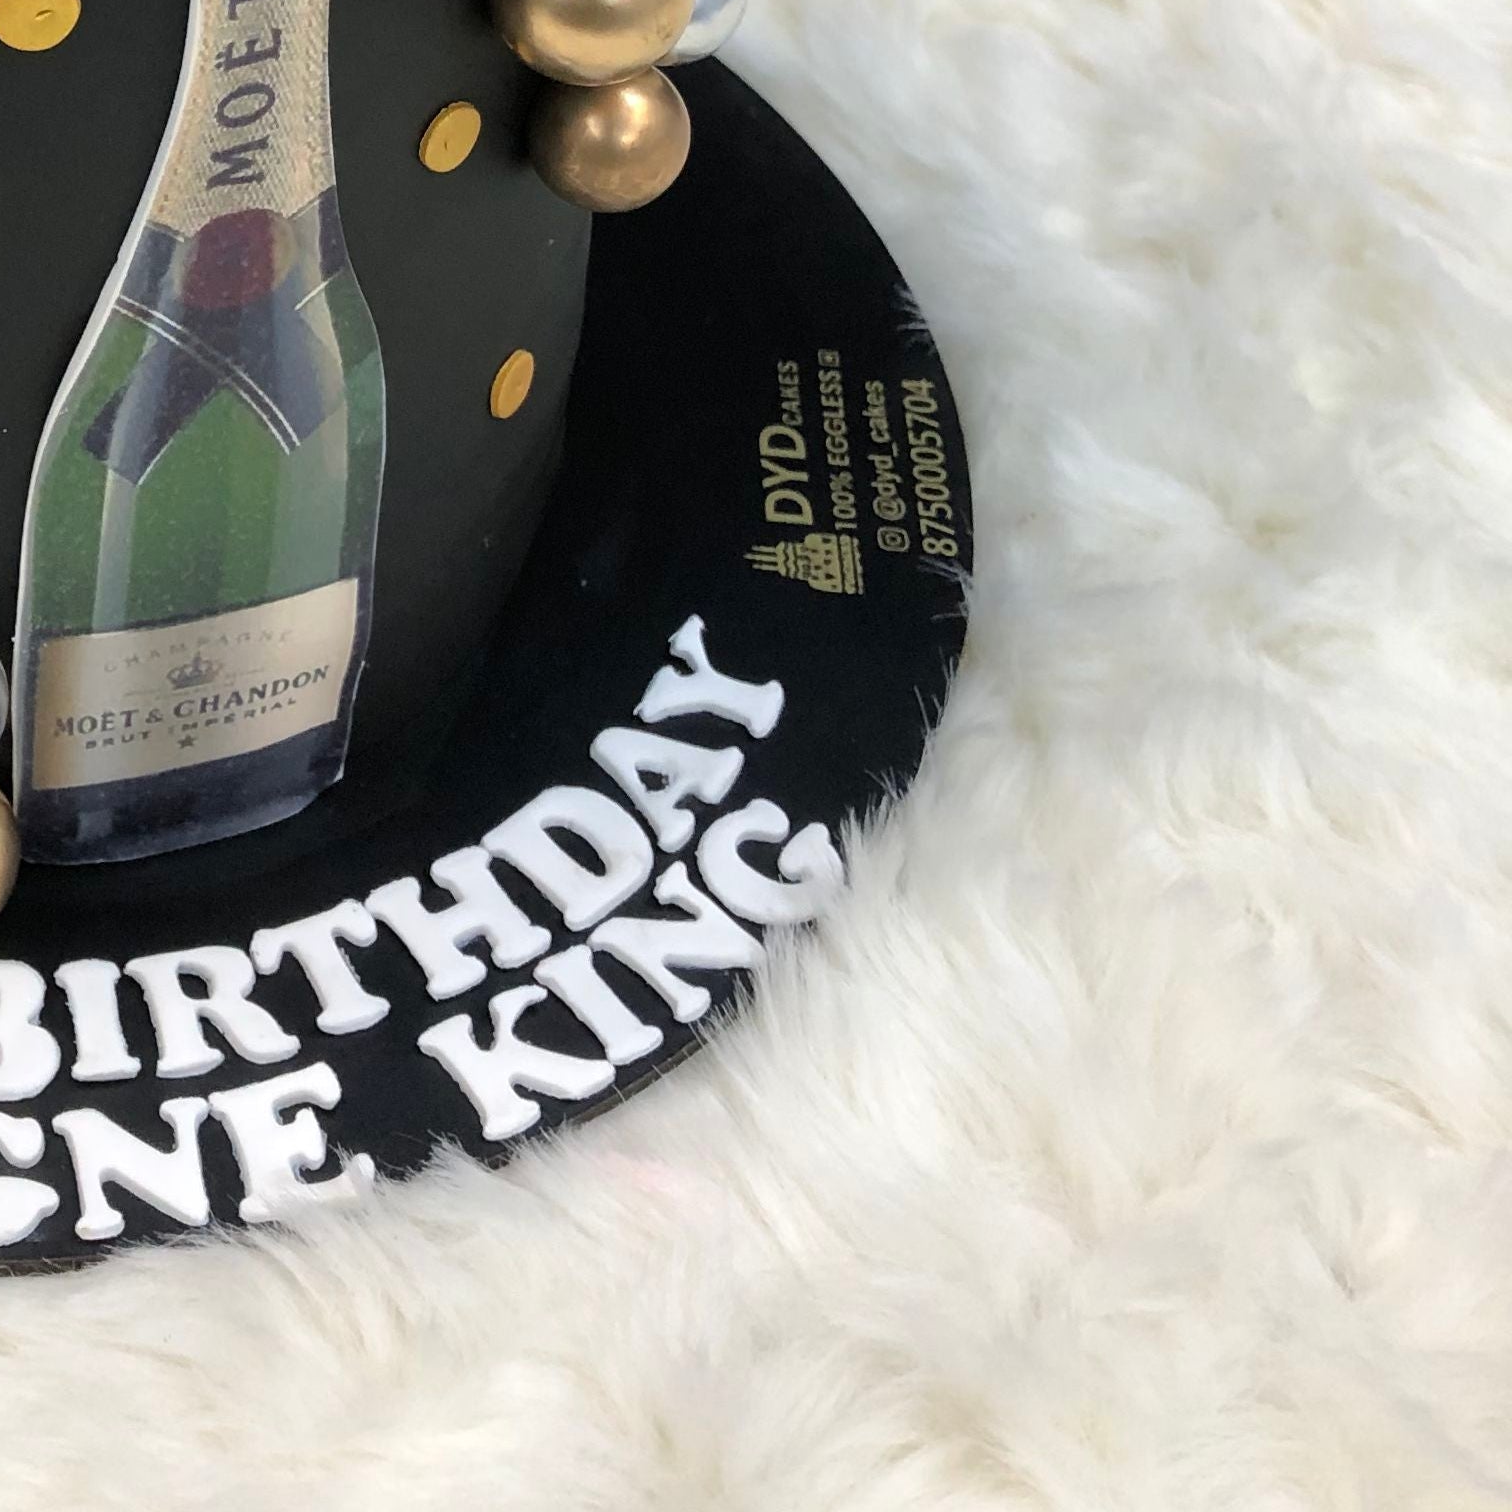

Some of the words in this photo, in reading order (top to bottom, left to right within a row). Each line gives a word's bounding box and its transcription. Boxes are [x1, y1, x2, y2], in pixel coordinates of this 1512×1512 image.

[777, 360, 803, 425] CAKES
[818, 369, 851, 467] EGGLESS
[758, 425, 813, 526] DYD
[829, 470, 858, 530] 100%
[901, 377, 959, 557] 8750005704
[145, 708, 164, 724] &
[173, 664, 329, 718] CHANDON
[85, 730, 150, 749] BRUT
[416, 798, 844, 1141] KING
